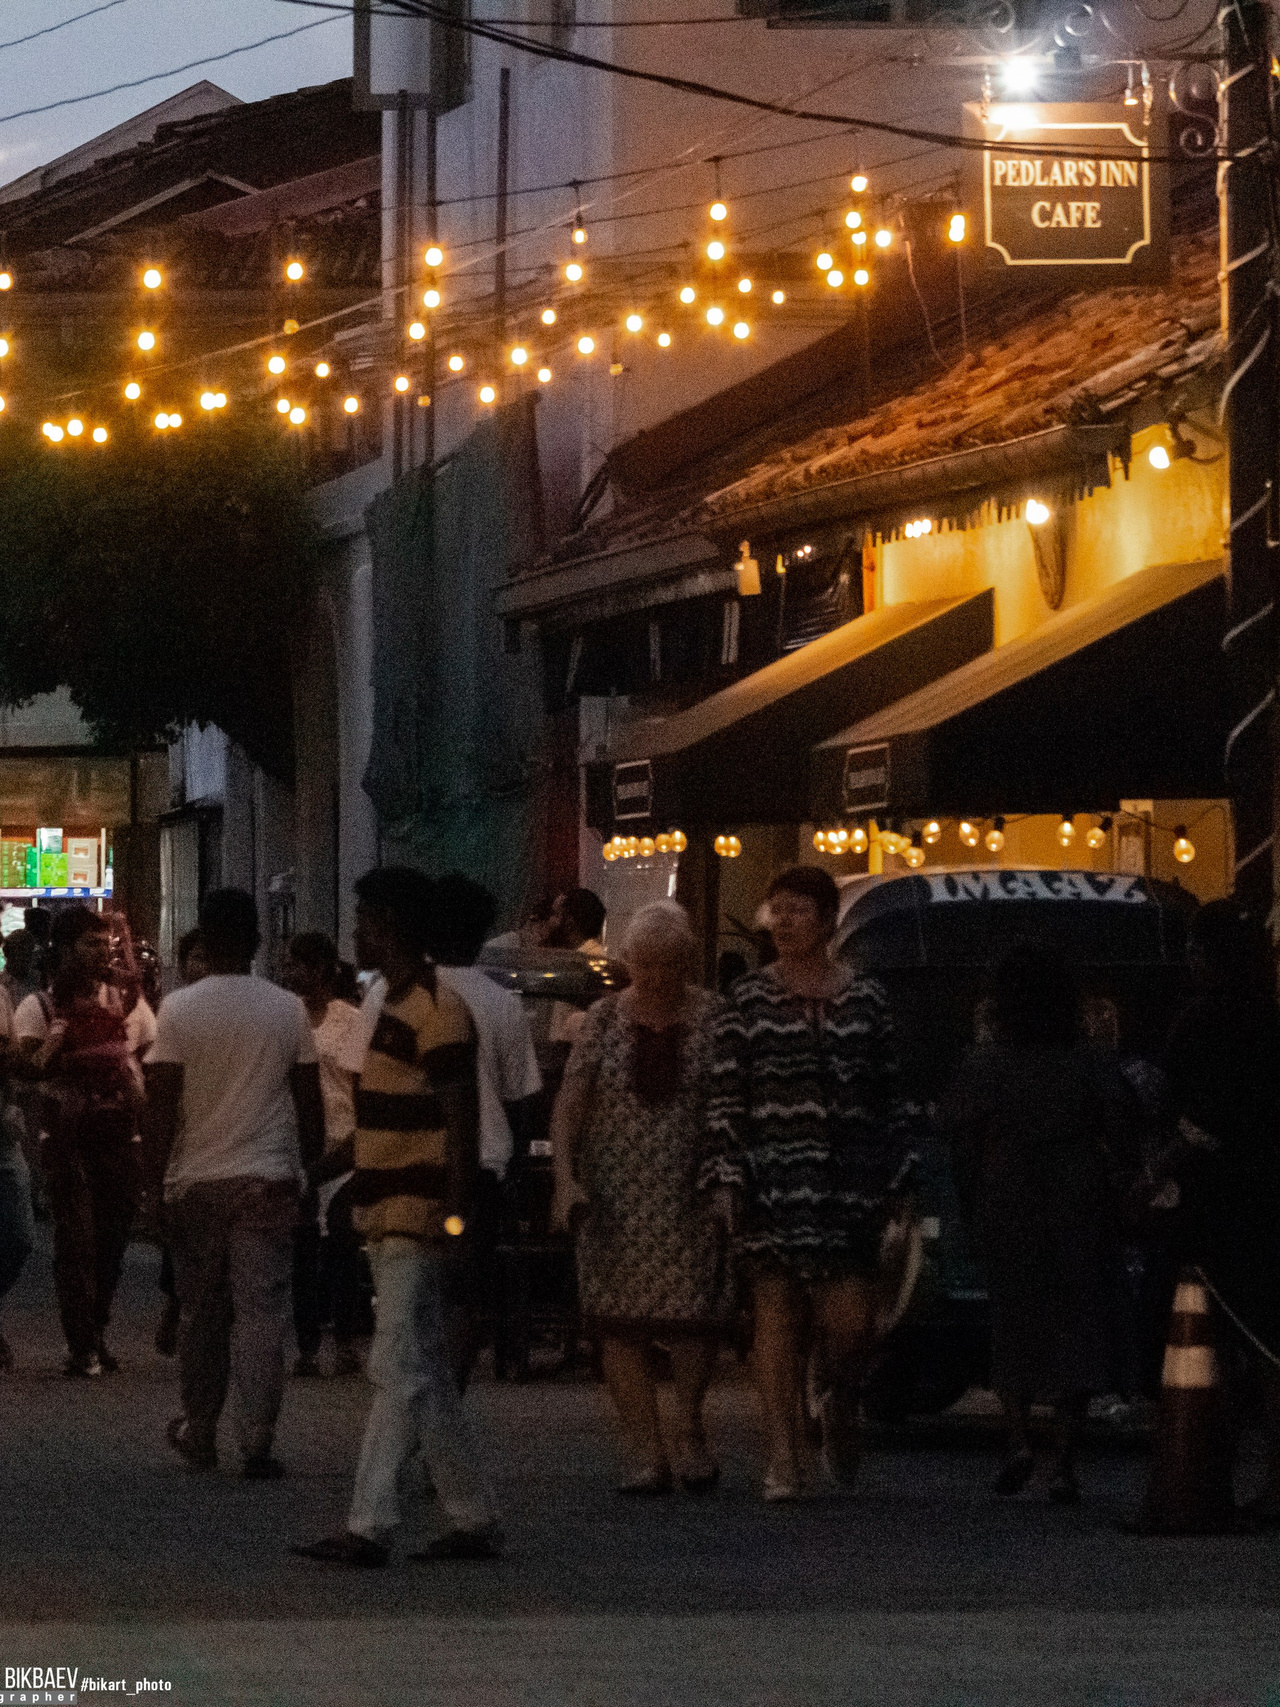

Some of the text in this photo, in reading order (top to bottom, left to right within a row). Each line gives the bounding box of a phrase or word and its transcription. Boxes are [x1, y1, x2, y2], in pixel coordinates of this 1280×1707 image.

[993, 160, 1138, 187] PEDLAR'S INN
[1031, 201, 1102, 228] CAFE
